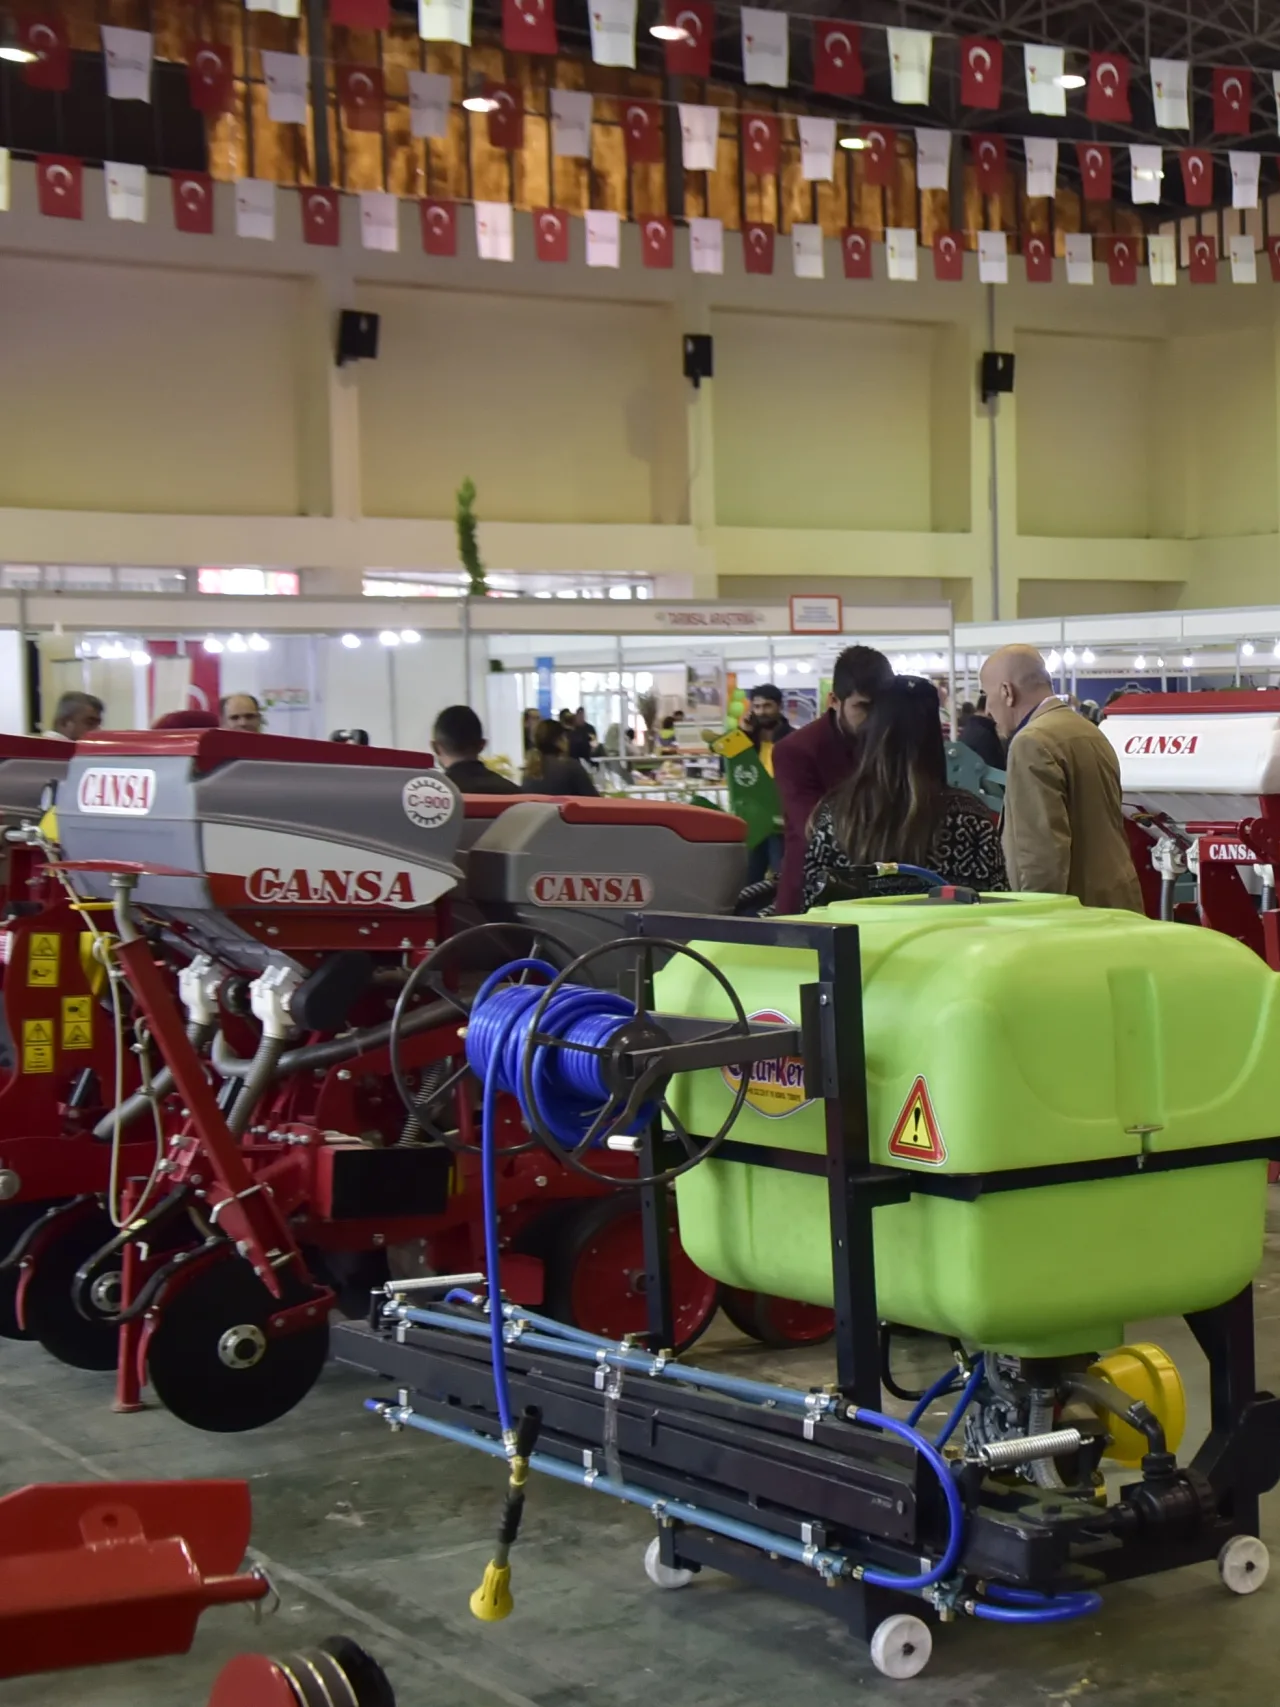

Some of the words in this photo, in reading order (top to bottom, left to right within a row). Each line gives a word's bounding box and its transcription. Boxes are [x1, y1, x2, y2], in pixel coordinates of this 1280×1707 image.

[1124, 735, 1198, 754] CANSA
[82, 773, 149, 809] CANSA
[408, 794, 450, 809] C-900
[249, 867, 417, 903] CANSA
[535, 876, 644, 902] CANSA
